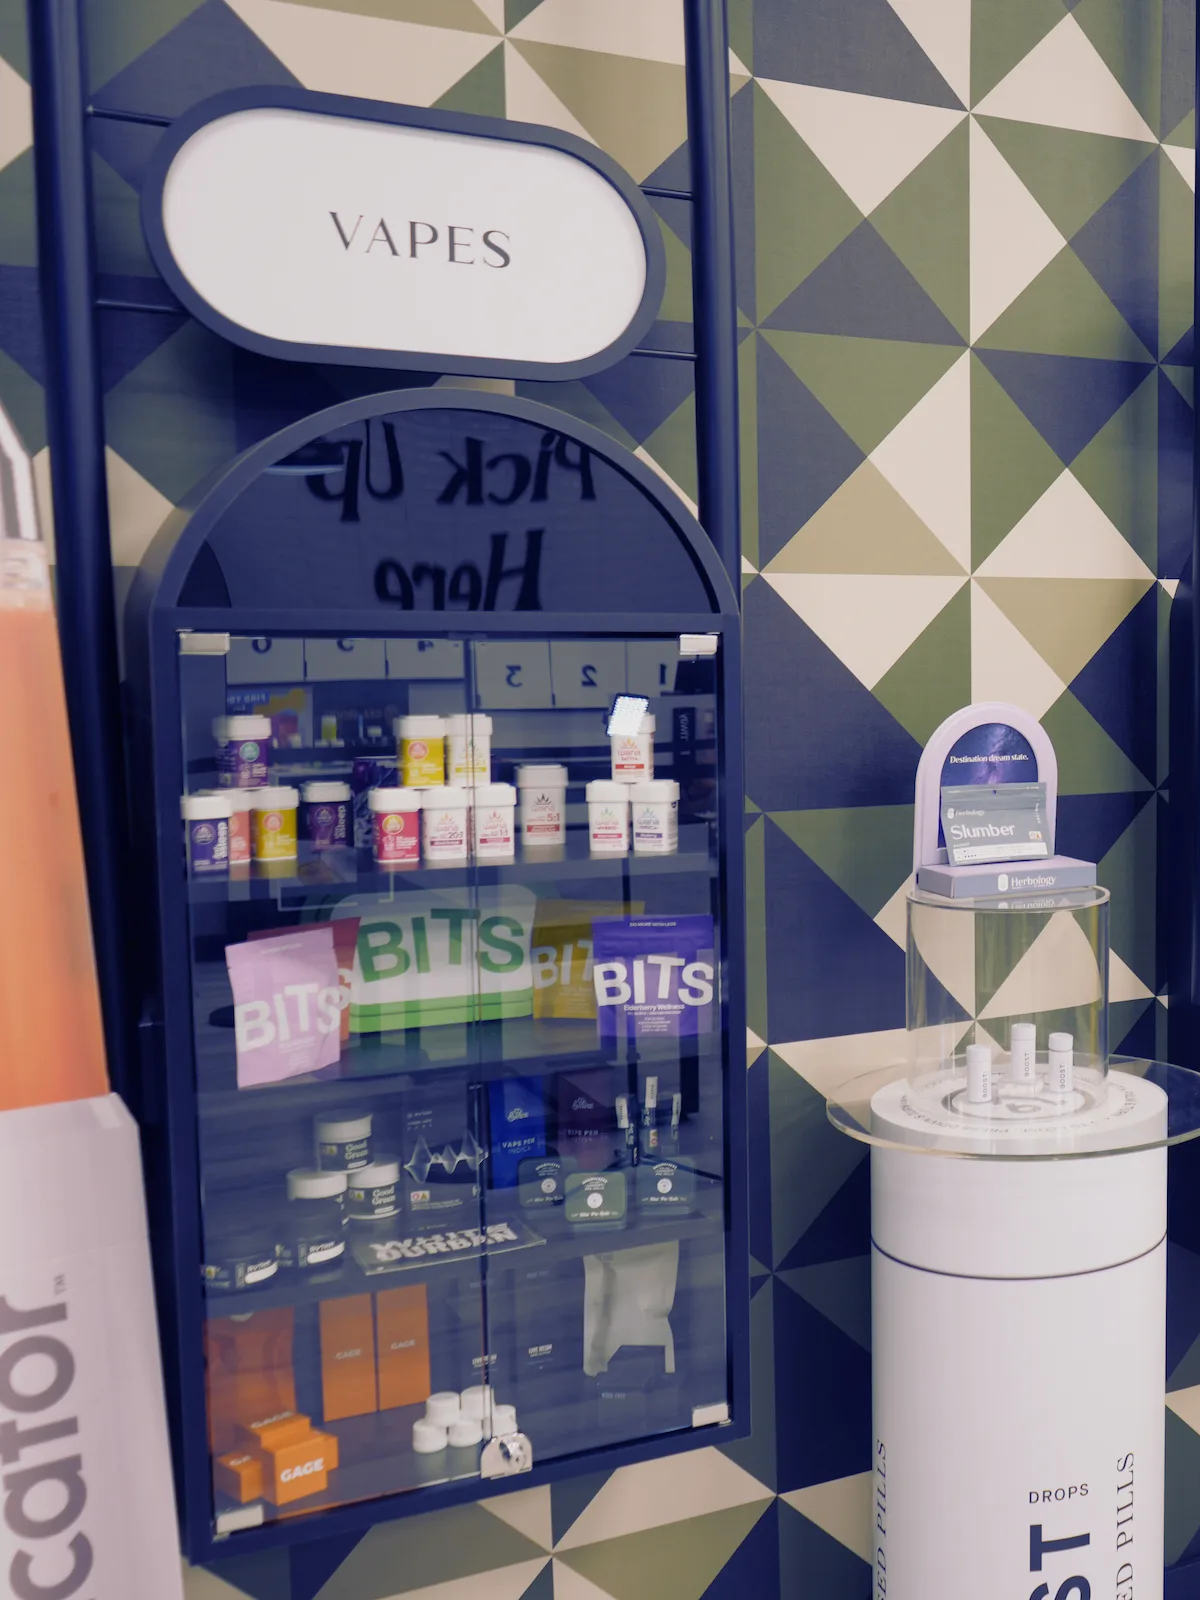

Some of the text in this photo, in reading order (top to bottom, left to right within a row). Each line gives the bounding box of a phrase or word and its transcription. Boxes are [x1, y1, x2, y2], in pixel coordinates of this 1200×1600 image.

[328, 211, 512, 270] VAPES
[950, 753, 1029, 763] Destination dream state.
[955, 808, 985, 817] Herbology
[950, 823, 1015, 841] Slumber
[1011, 874, 1057, 887] Herbology
[356, 906, 526, 984] BITS
[531, 939, 594, 990] BIT
[592, 954, 715, 1007] BITS
[623, 1003, 685, 1012] Elderberry Wellness
[235, 982, 341, 1053] BITS
[344, 1140, 368, 1151] Good
[344, 1149, 369, 1160] Green
[371, 1194, 397, 1206] Green
[372, 1185, 395, 1197] Good
[390, 1339, 416, 1350] GAGE
[335, 1348, 361, 1360] GAGE
[0, 1294, 94, 1600] cator
[280, 1457, 325, 1483] GAGE
[876, 1438, 887, 1537] PILLS
[1028, 1483, 1090, 1504] DROPS
[1116, 1452, 1135, 1552] PILLS
